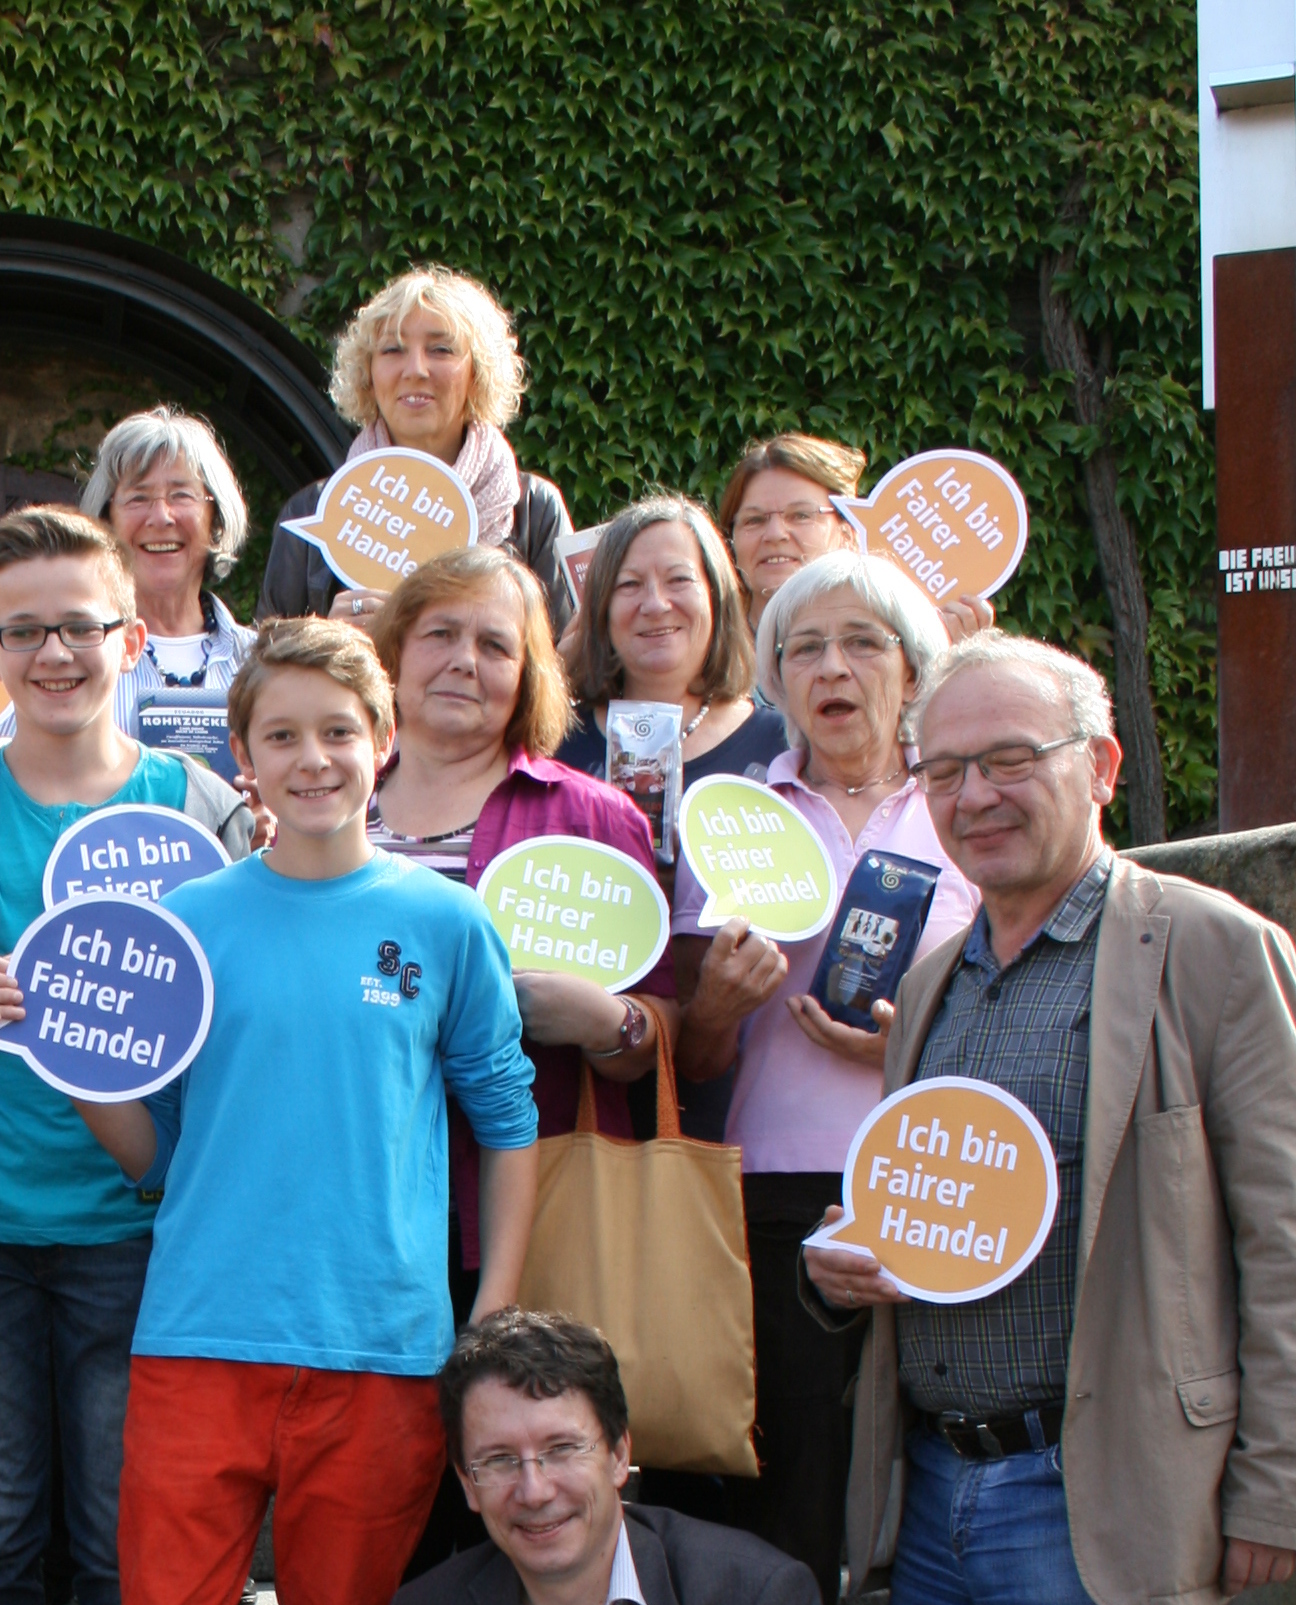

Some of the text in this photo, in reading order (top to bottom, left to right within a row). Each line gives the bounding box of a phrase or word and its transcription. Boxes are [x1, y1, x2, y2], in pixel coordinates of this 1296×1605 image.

[339, 484, 416, 540] Fairer
[370, 465, 455, 528] Ich bin
[896, 478, 961, 551] Fairer
[933, 466, 1004, 551] Ich bin
[337, 519, 418, 577] Hande
[879, 513, 958, 600] Handel
[1219, 549, 1247, 571] DIE
[1226, 571, 1254, 593] IST
[142, 717, 228, 727] ROHRZUCKE
[698, 805, 785, 837] Ich bin
[80, 835, 191, 871] Ich bin
[699, 842, 774, 872] Fairer
[498, 886, 595, 931] Fairer
[523, 859, 632, 906] Ich bin
[728, 871, 821, 906] Handel
[59, 924, 177, 983] Ich bin
[510, 924, 628, 972] Handel
[29, 961, 134, 1015] Fairer
[38, 1007, 166, 1068] Handel
[897, 1114, 1018, 1171] Ich bin
[868, 1156, 975, 1209] Fairer
[879, 1205, 1008, 1265] Handel
